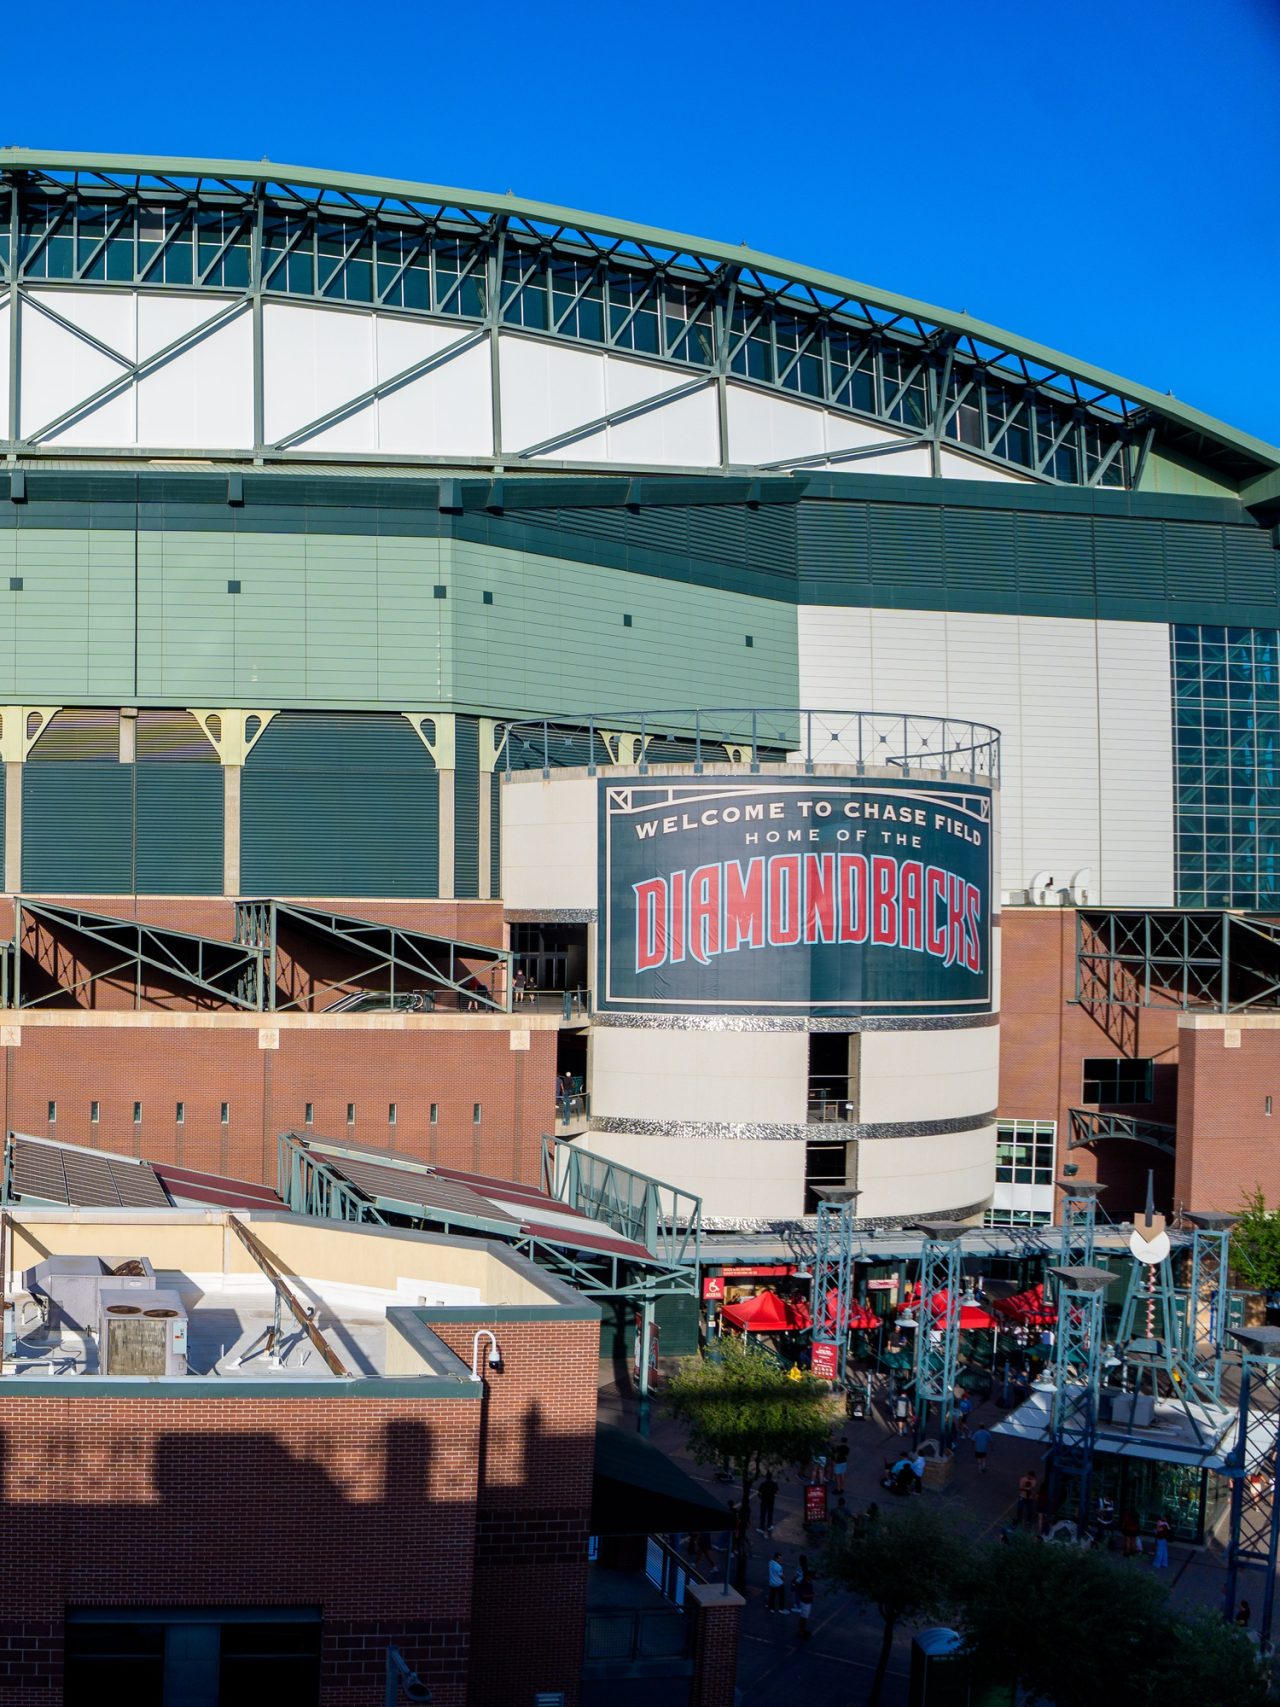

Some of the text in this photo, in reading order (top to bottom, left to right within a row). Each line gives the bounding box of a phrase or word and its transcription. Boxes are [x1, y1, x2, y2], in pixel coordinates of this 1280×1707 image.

[635, 801, 981, 847] WELCOME TO CHASE FIELD
[745, 829, 922, 849] HOME OF THE
[631, 852, 981, 975] DIAMONDBACKS
